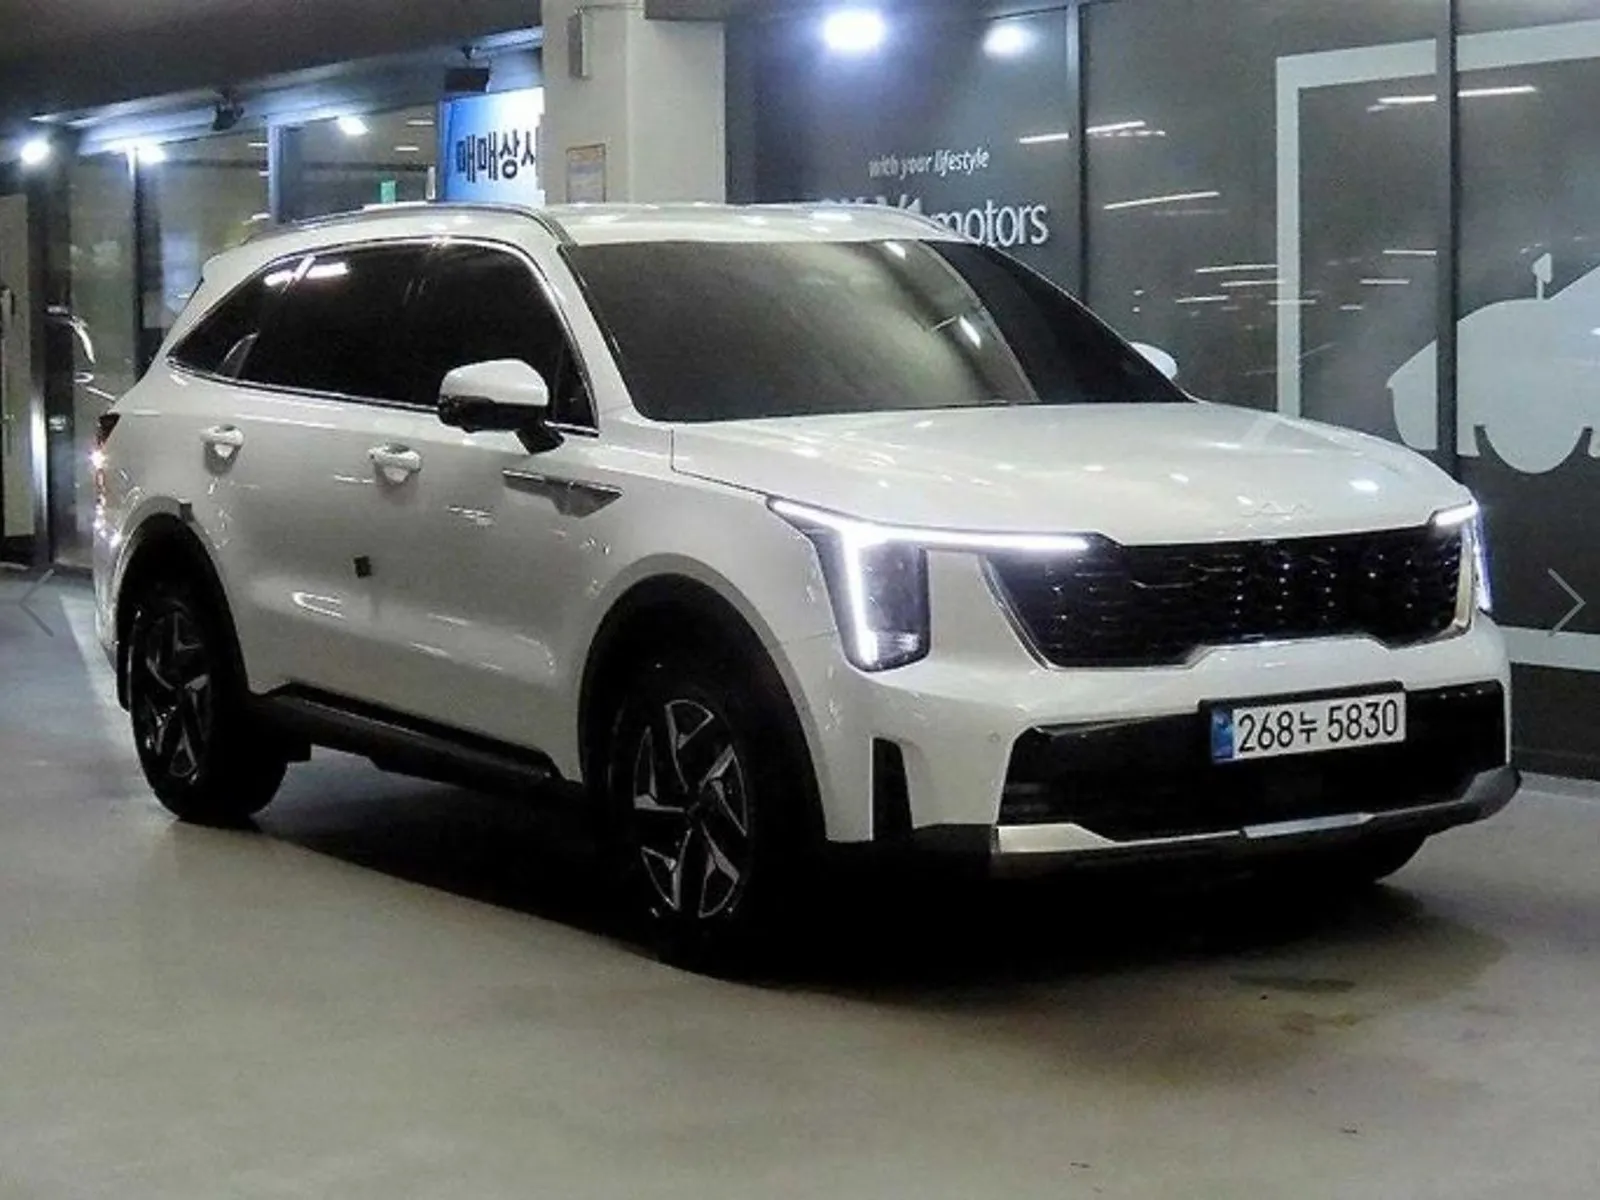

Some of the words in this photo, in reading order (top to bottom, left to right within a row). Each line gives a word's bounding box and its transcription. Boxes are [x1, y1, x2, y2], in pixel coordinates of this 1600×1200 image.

[868, 154, 899, 178] with
[900, 155, 932, 180] your
[934, 146, 990, 177] lifestyle
[1238, 711, 1318, 753] 268누
[1327, 699, 1398, 743] 5830
